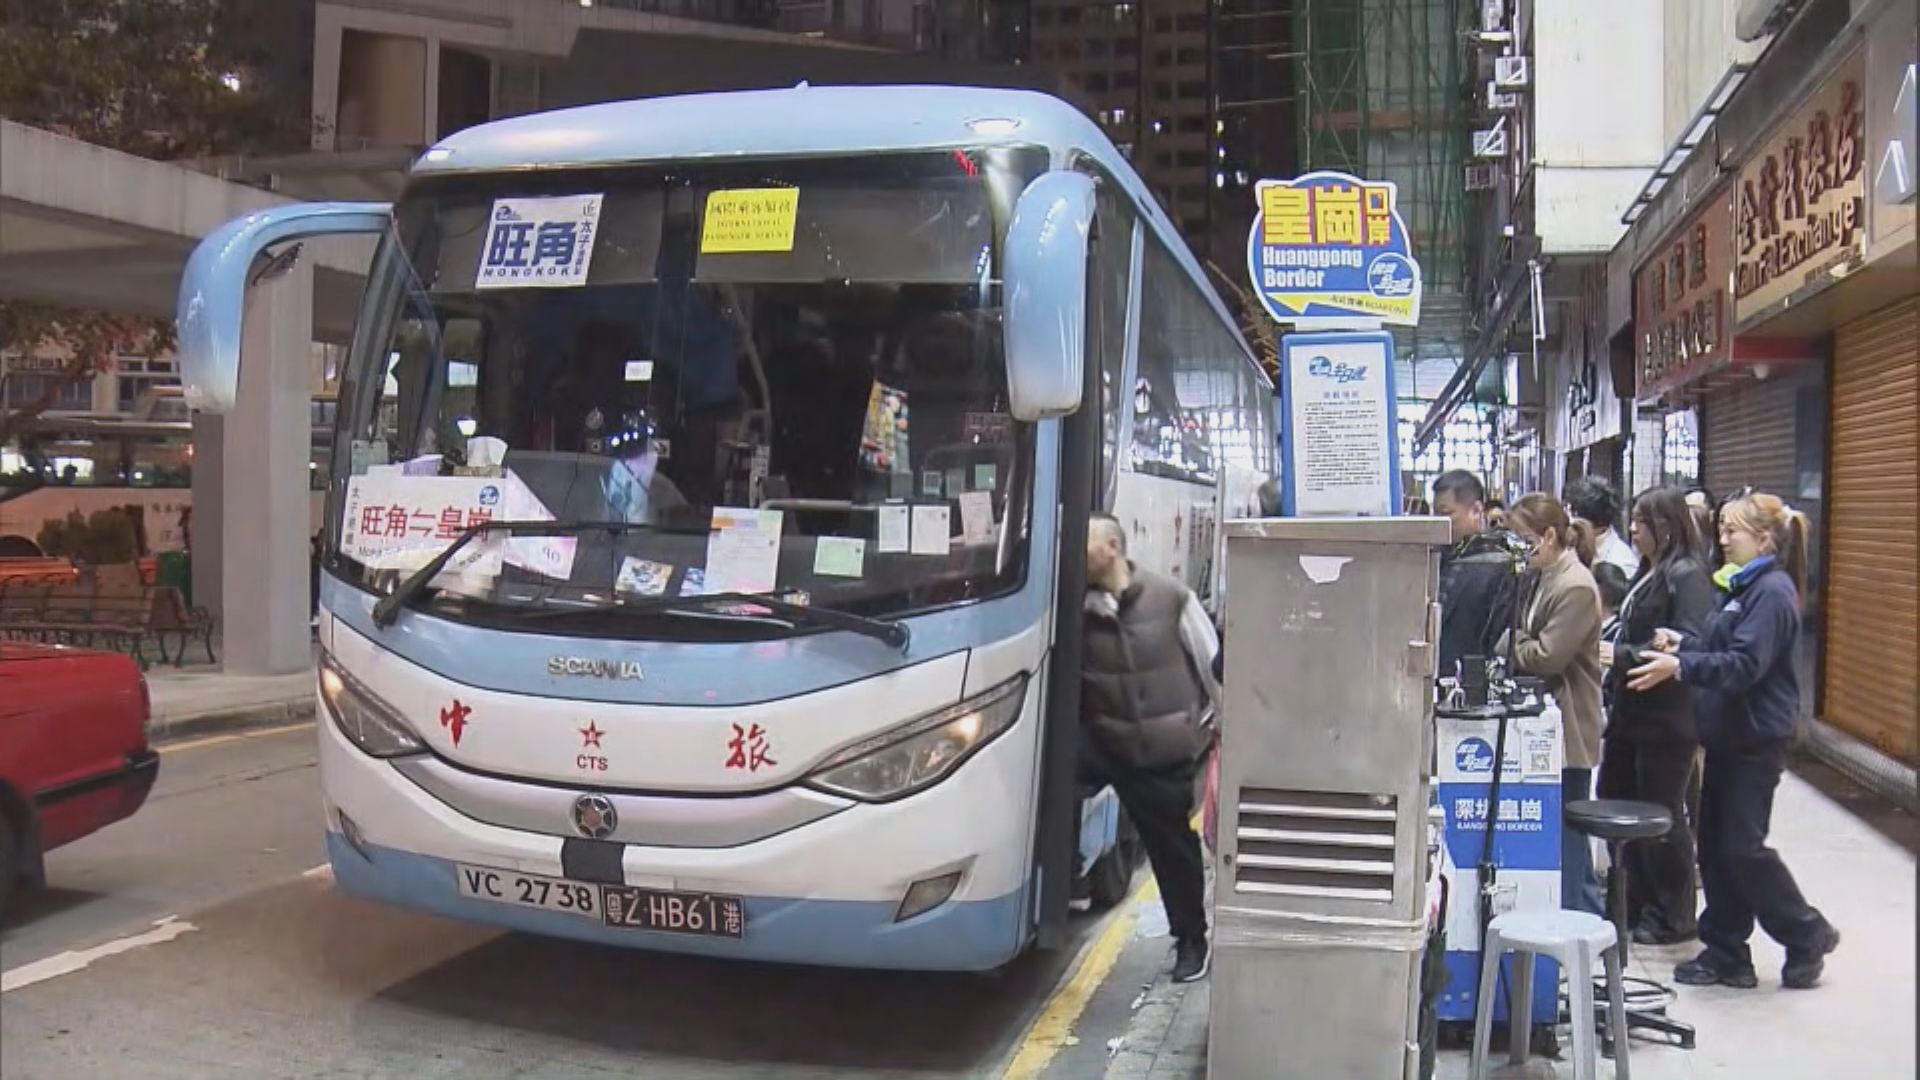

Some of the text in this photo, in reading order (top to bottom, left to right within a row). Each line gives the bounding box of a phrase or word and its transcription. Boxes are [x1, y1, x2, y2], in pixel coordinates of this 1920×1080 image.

[487, 222, 577, 267] 旺角
[1780, 198, 1854, 270] Exchange
[483, 266, 569, 277] MONGKOK
[1264, 268, 1325, 288] Border
[548, 656, 645, 680] SCANIA
[576, 754, 608, 771] CTS
[465, 869, 592, 912] VC 2738
